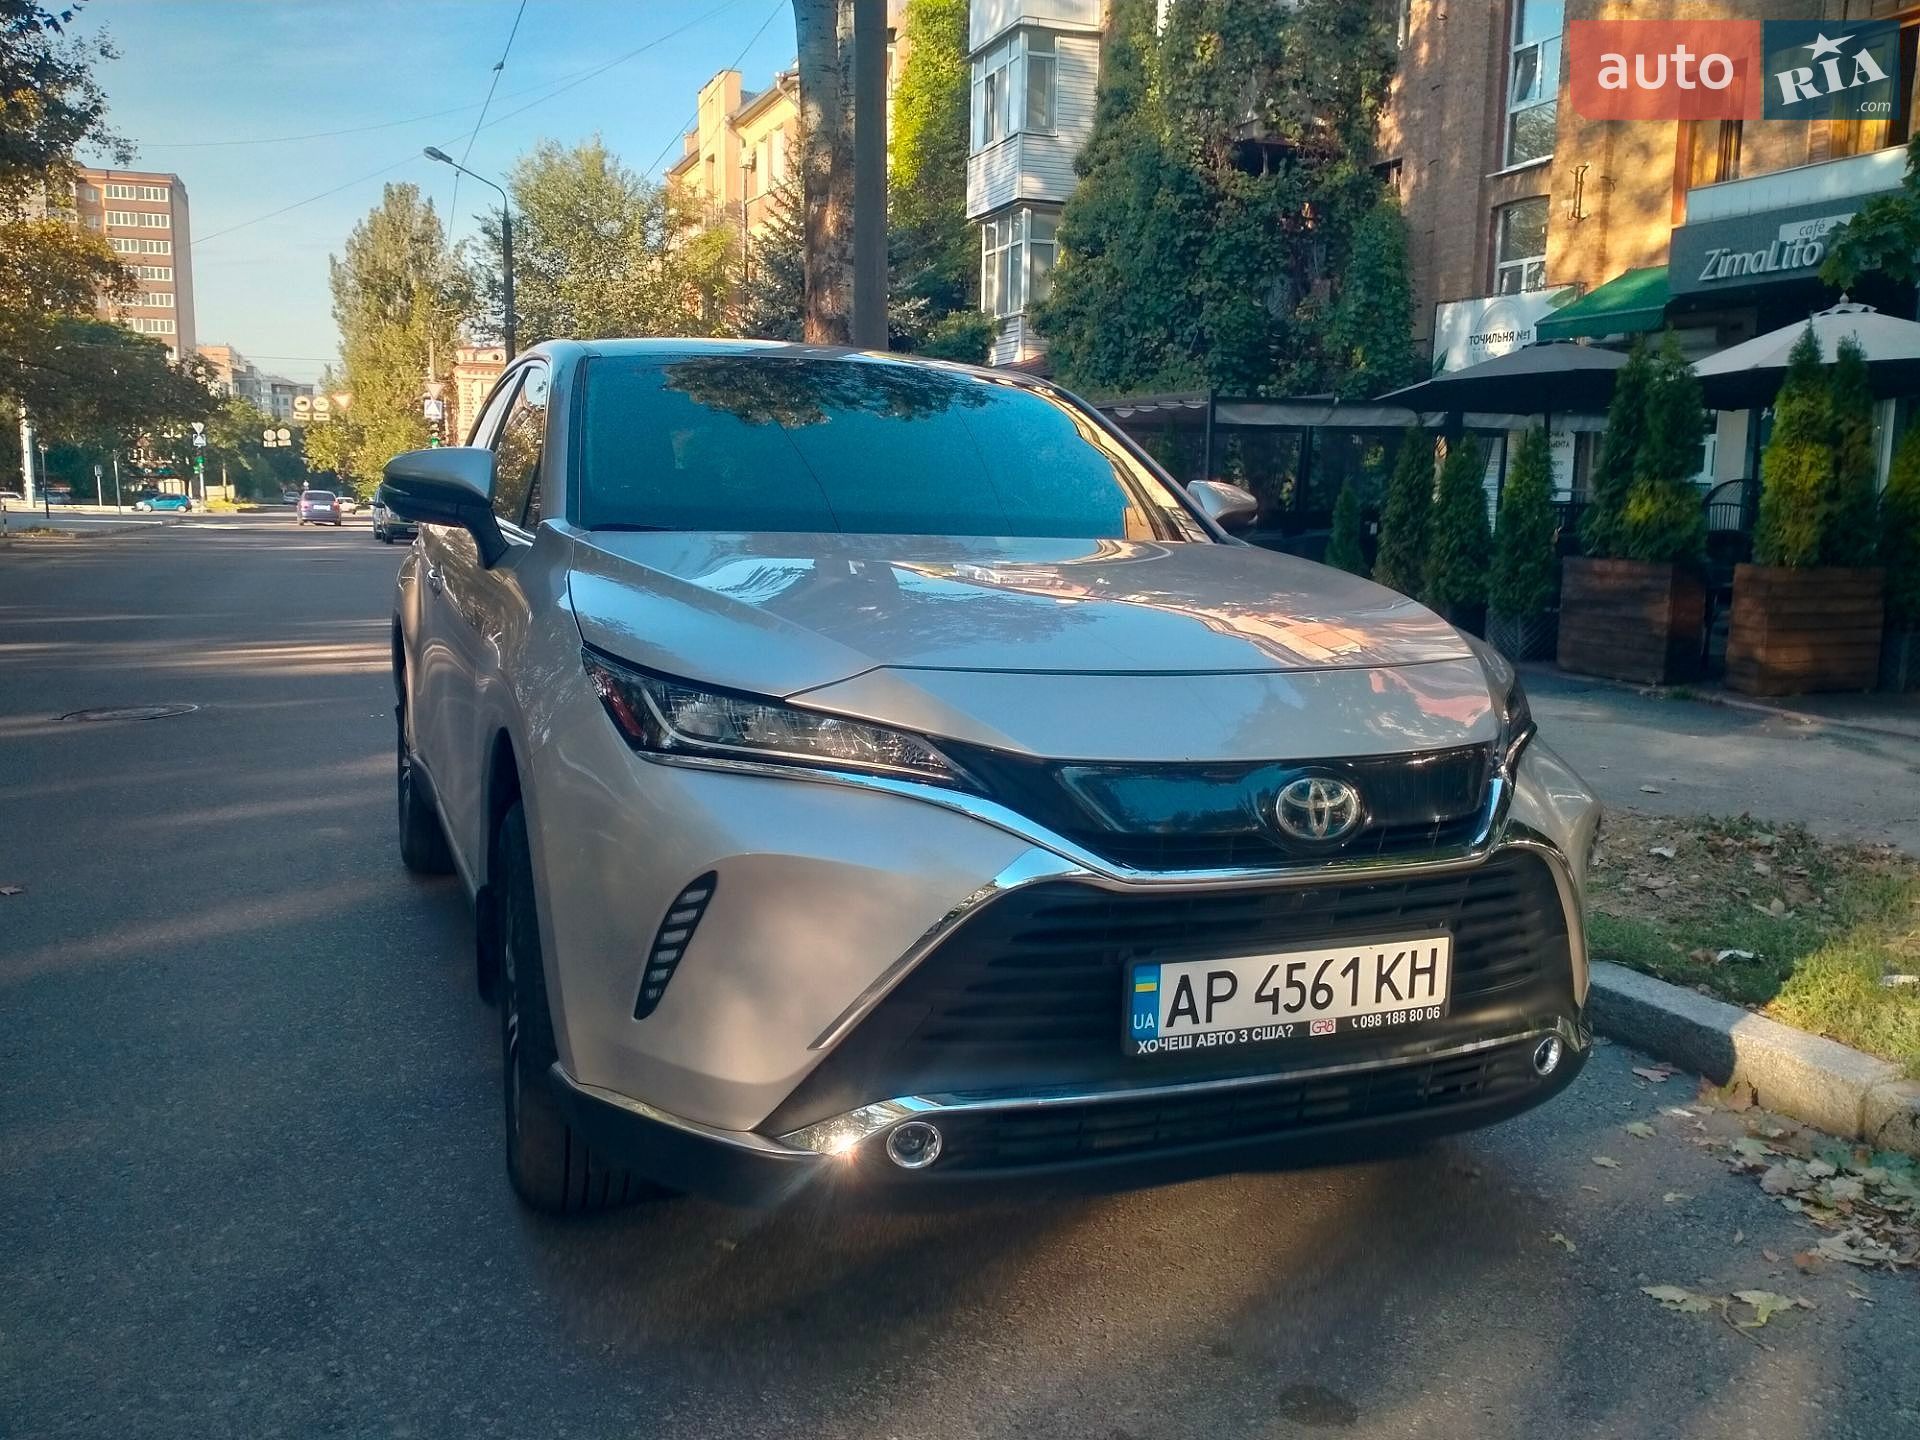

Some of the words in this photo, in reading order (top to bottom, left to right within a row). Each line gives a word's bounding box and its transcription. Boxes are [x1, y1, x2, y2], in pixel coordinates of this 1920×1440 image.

[1799, 218, 1826, 240] café
[1469, 330, 1515, 346] ТОЧИЛЬНЯ
[1165, 969, 1239, 1028] AP
[1254, 956, 1361, 1016] 4561
[1374, 947, 1439, 1004] KH
[1133, 1013, 1155, 1030] UA
[1360, 1014, 1382, 1029] 098
[1385, 1010, 1406, 1025] 188
[1409, 1008, 1424, 1022] 80
[1426, 1006, 1441, 1019] 06
[1137, 1034, 1193, 1055] ХОЧЕШ
[1195, 1030, 1236, 1048] АВТО
[1252, 1024, 1294, 1042] США?
